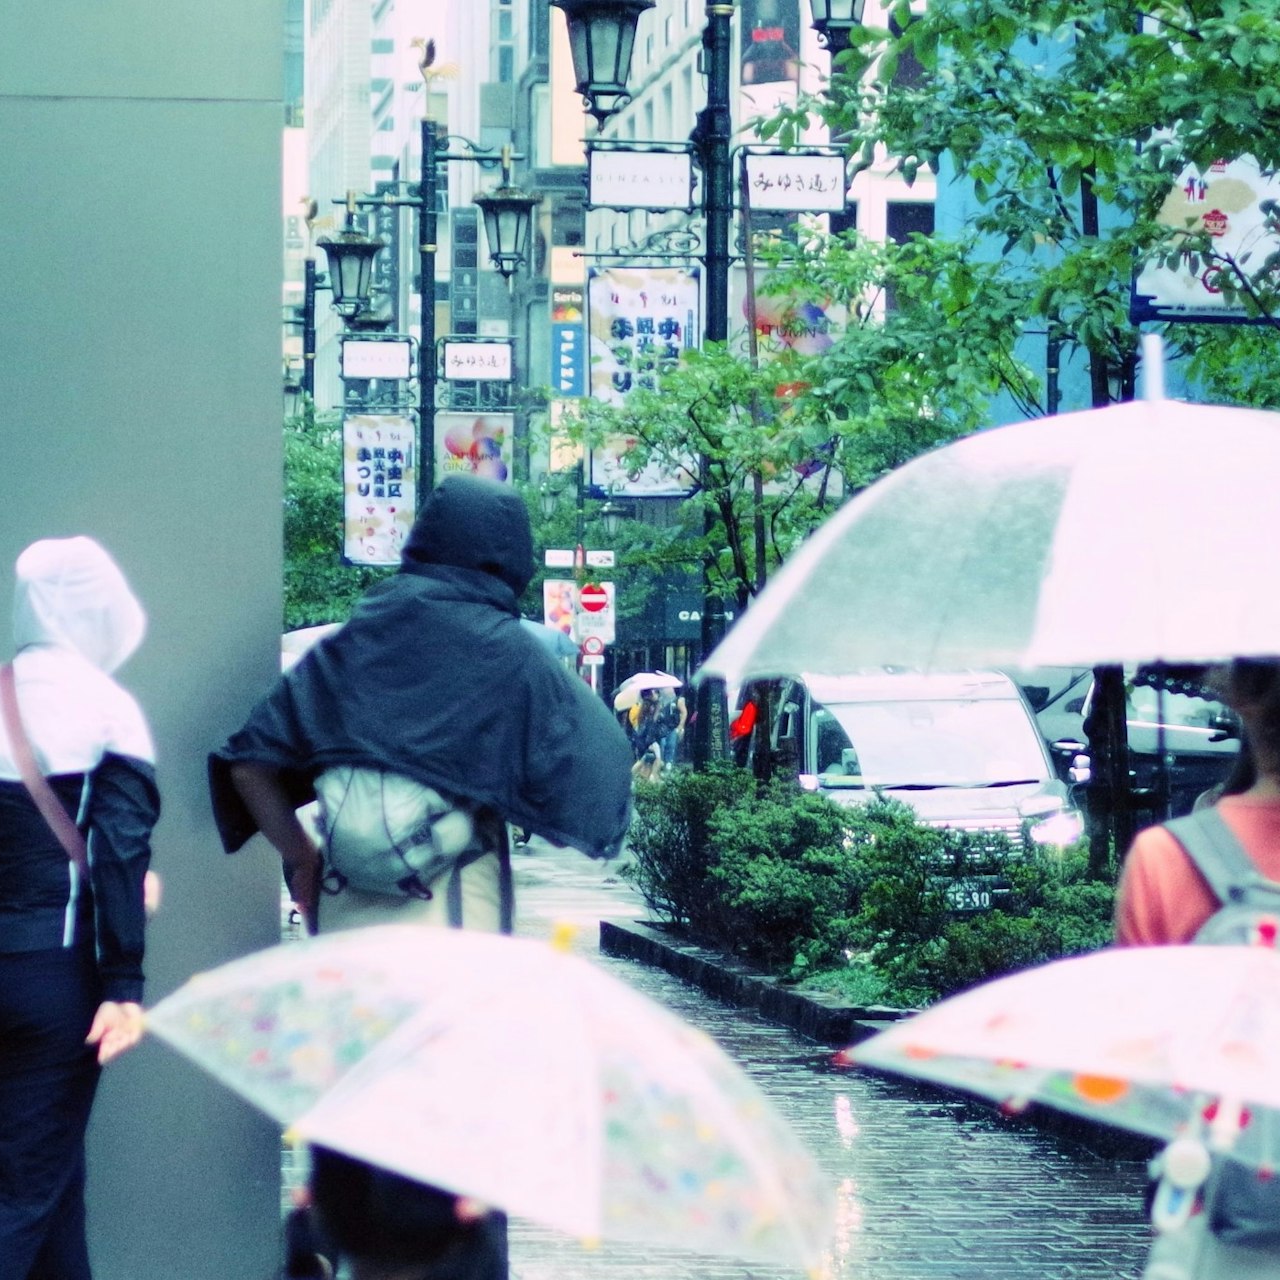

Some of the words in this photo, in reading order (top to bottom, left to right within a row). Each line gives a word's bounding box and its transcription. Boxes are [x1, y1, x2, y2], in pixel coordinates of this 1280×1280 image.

[595, 174, 650, 184] GINZA
[658, 175, 686, 185] SIX
[753, 172, 839, 194] みゆき通り
[553, 291, 583, 303] Seria
[560, 330, 575, 391] PLAZA
[356, 446, 372, 498] まつり
